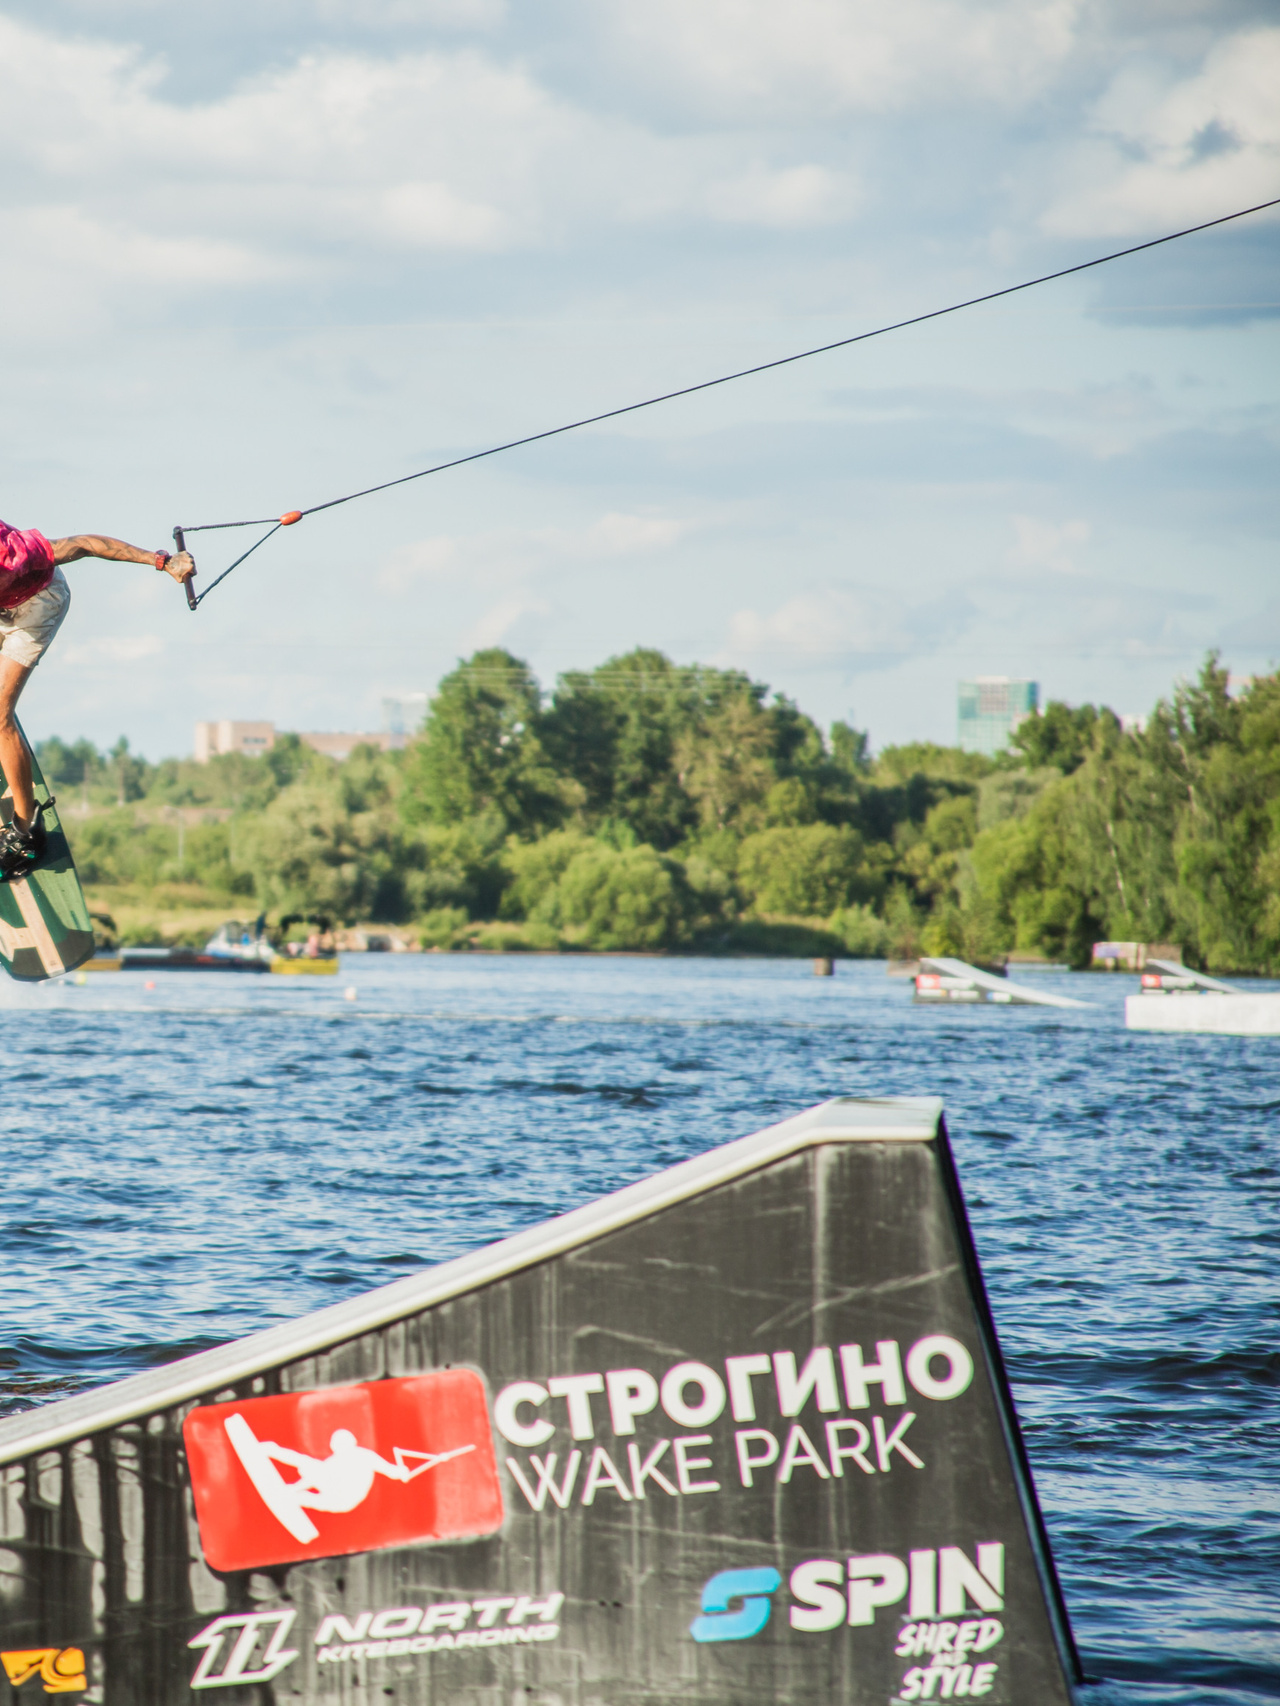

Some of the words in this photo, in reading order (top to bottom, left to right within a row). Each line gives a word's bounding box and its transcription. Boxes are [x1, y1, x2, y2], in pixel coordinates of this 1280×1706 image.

[494, 1334, 974, 1447] СТРОГИНО
[506, 1434, 720, 1511] WAKE
[735, 1412, 925, 1487] PARK
[790, 1542, 1004, 1632] SPIN
[314, 1592, 565, 1645] NORTH
[317, 1623, 560, 1663] KITEBOARDING
[894, 1617, 1004, 1658] SHRED
[900, 1662, 999, 1700] STYLE
